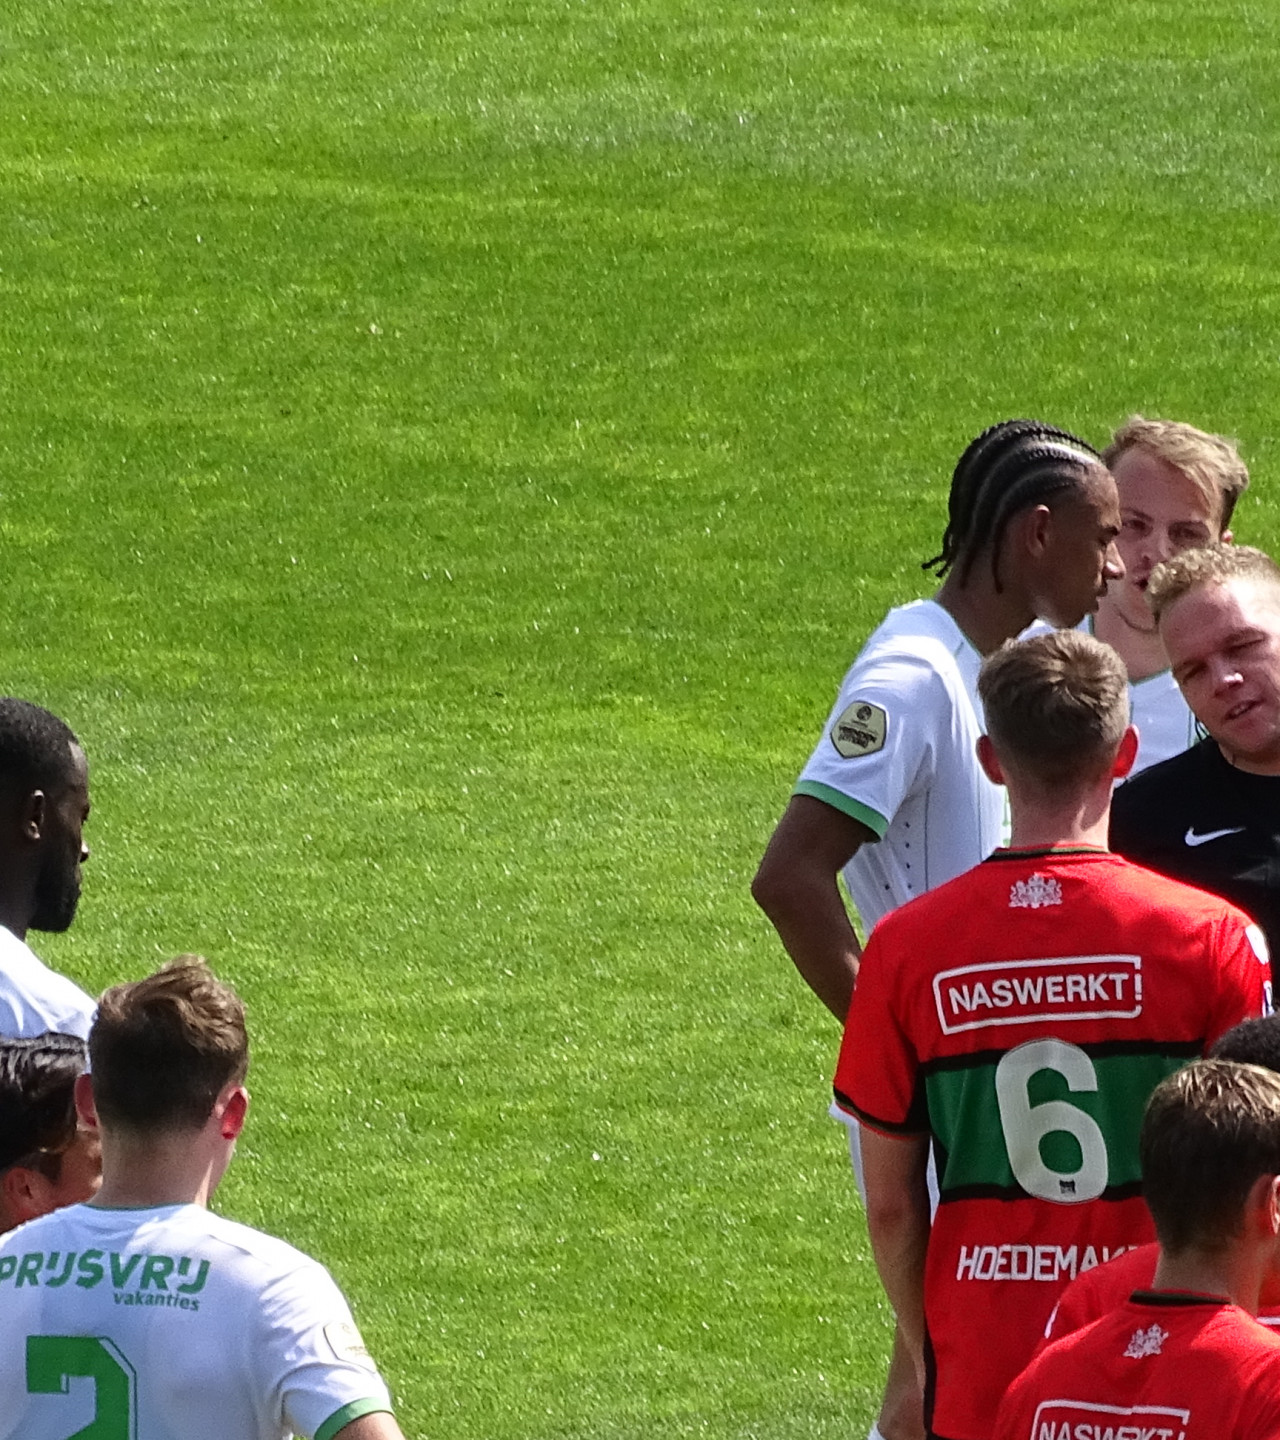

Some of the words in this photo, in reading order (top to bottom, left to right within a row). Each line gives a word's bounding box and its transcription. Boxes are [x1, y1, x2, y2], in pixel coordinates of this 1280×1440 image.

[948, 972, 1143, 1015] NASWERKT!
[995, 1037, 1109, 1205] 6
[113, 1291, 200, 1312] vakanties
